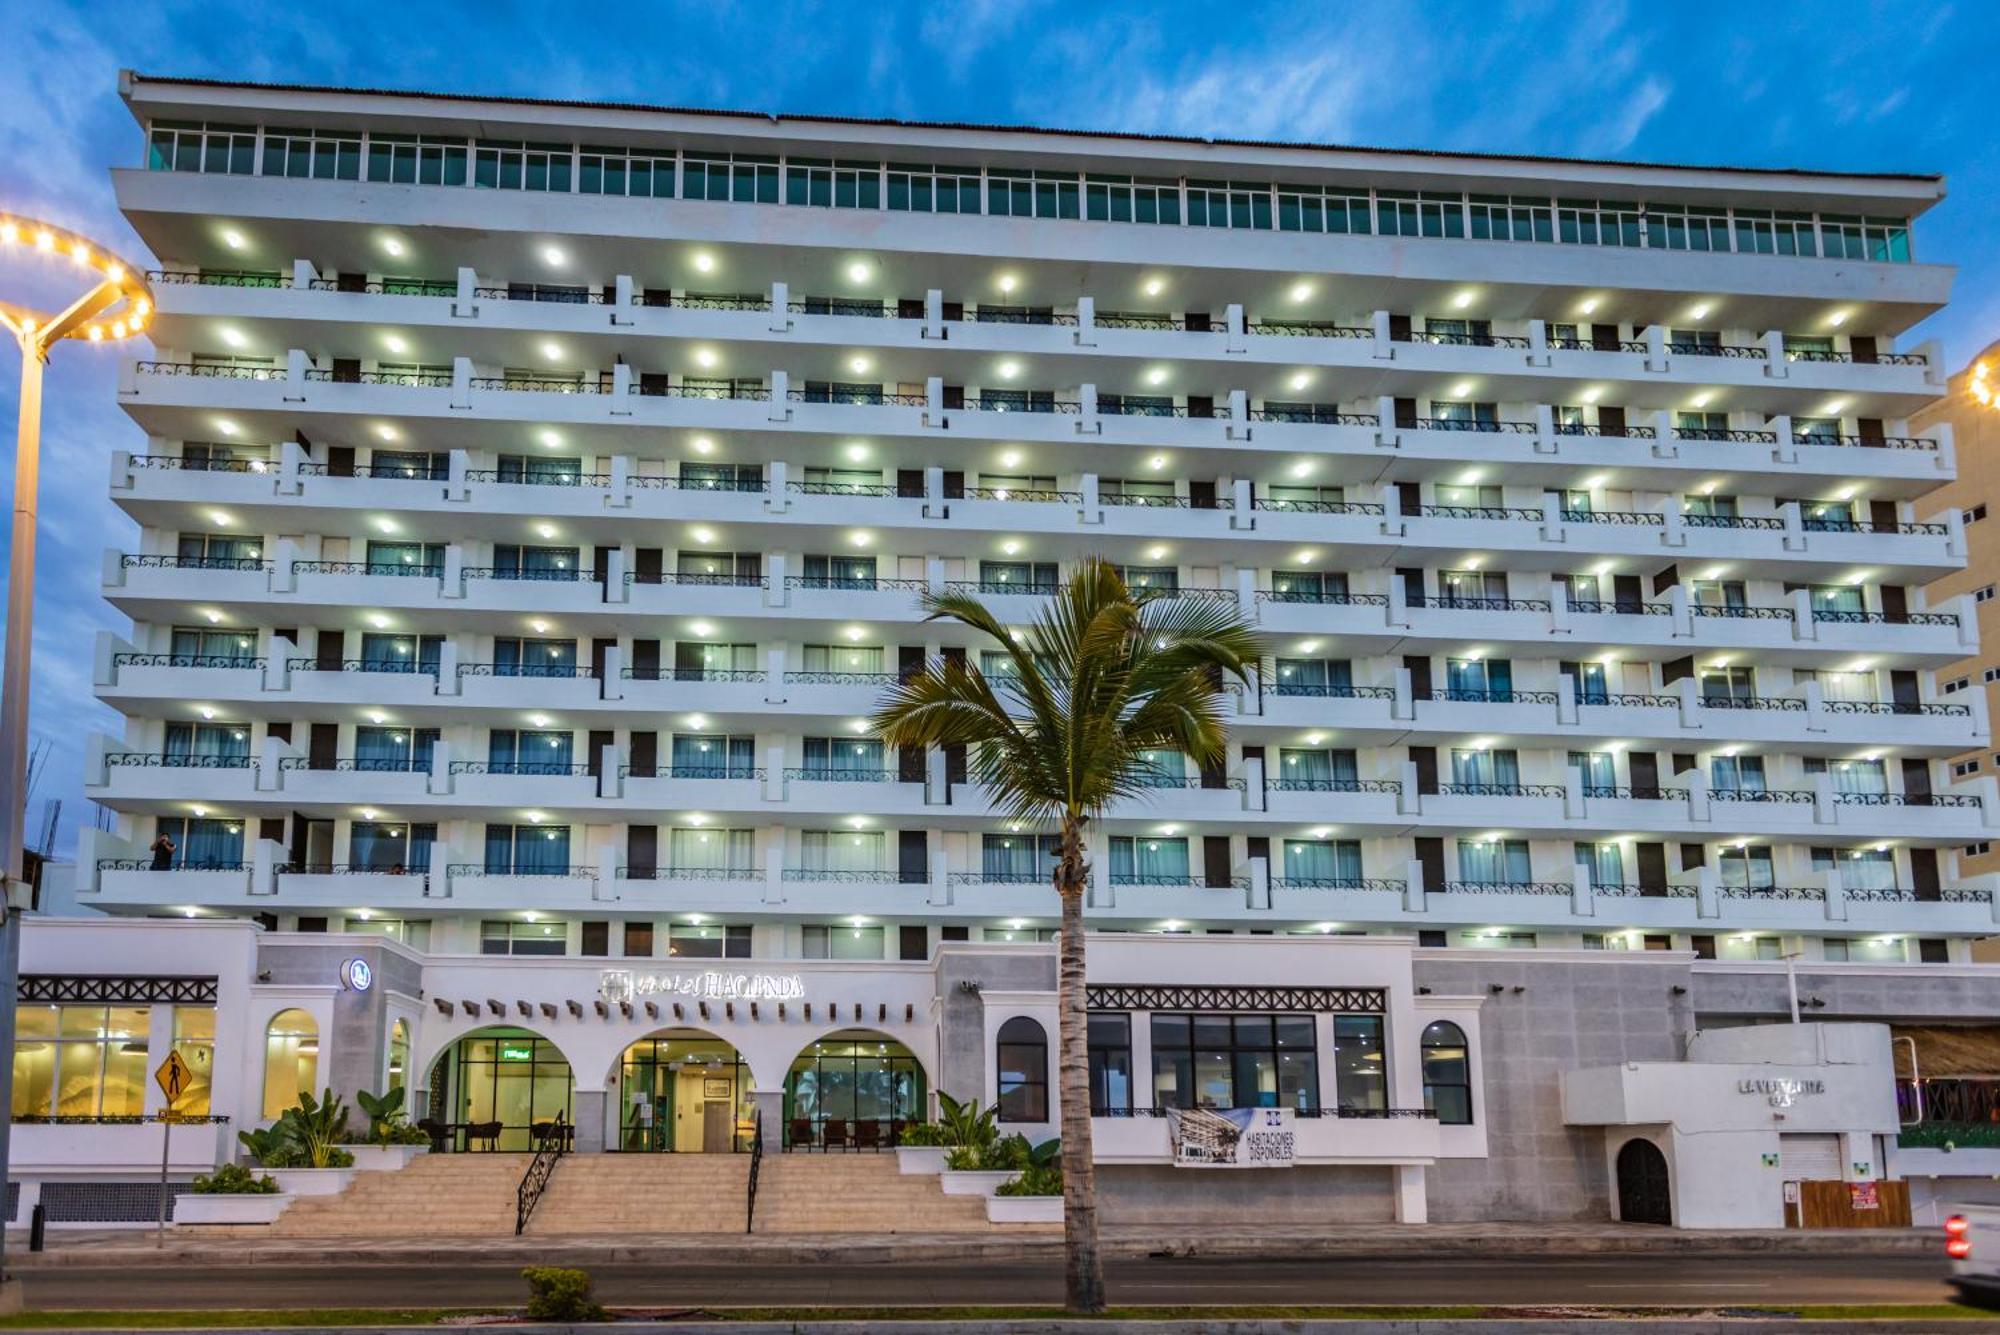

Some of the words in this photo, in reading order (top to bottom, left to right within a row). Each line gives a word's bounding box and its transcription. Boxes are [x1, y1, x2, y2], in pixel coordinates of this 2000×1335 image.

[704, 972, 804, 998] HACIENDA
[1247, 1131, 1294, 1146] HABITACIONES
[1249, 1146, 1293, 1160] DISPONIBLES
